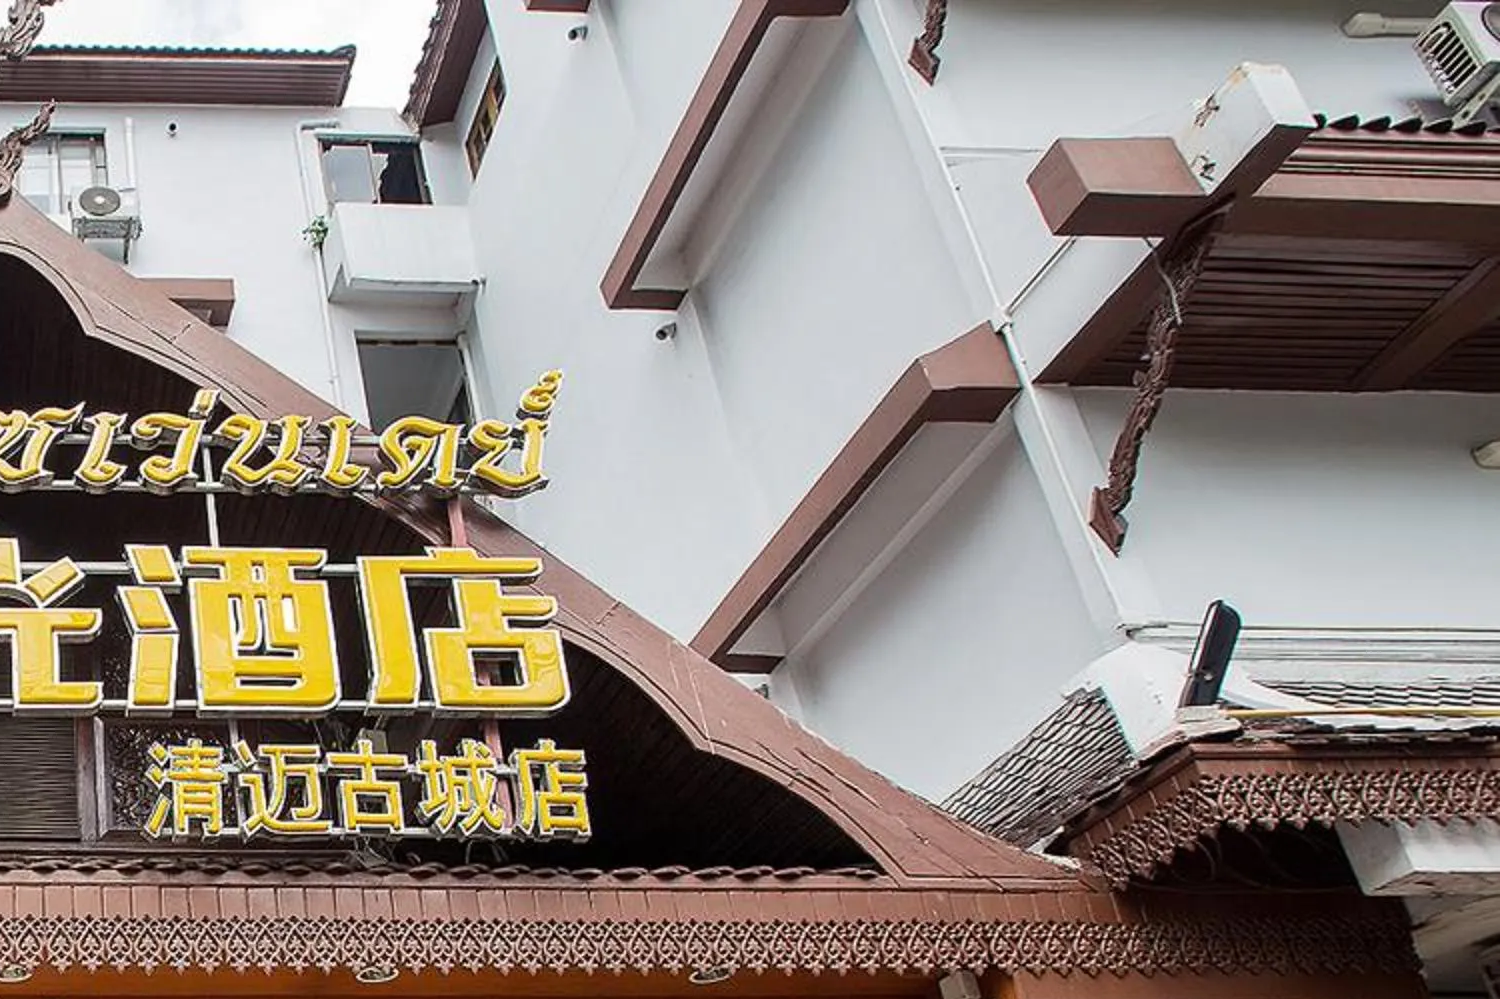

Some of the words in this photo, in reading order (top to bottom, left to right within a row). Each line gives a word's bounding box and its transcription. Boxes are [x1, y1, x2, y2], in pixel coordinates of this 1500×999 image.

[143, 737, 594, 840] 清迈古城店
